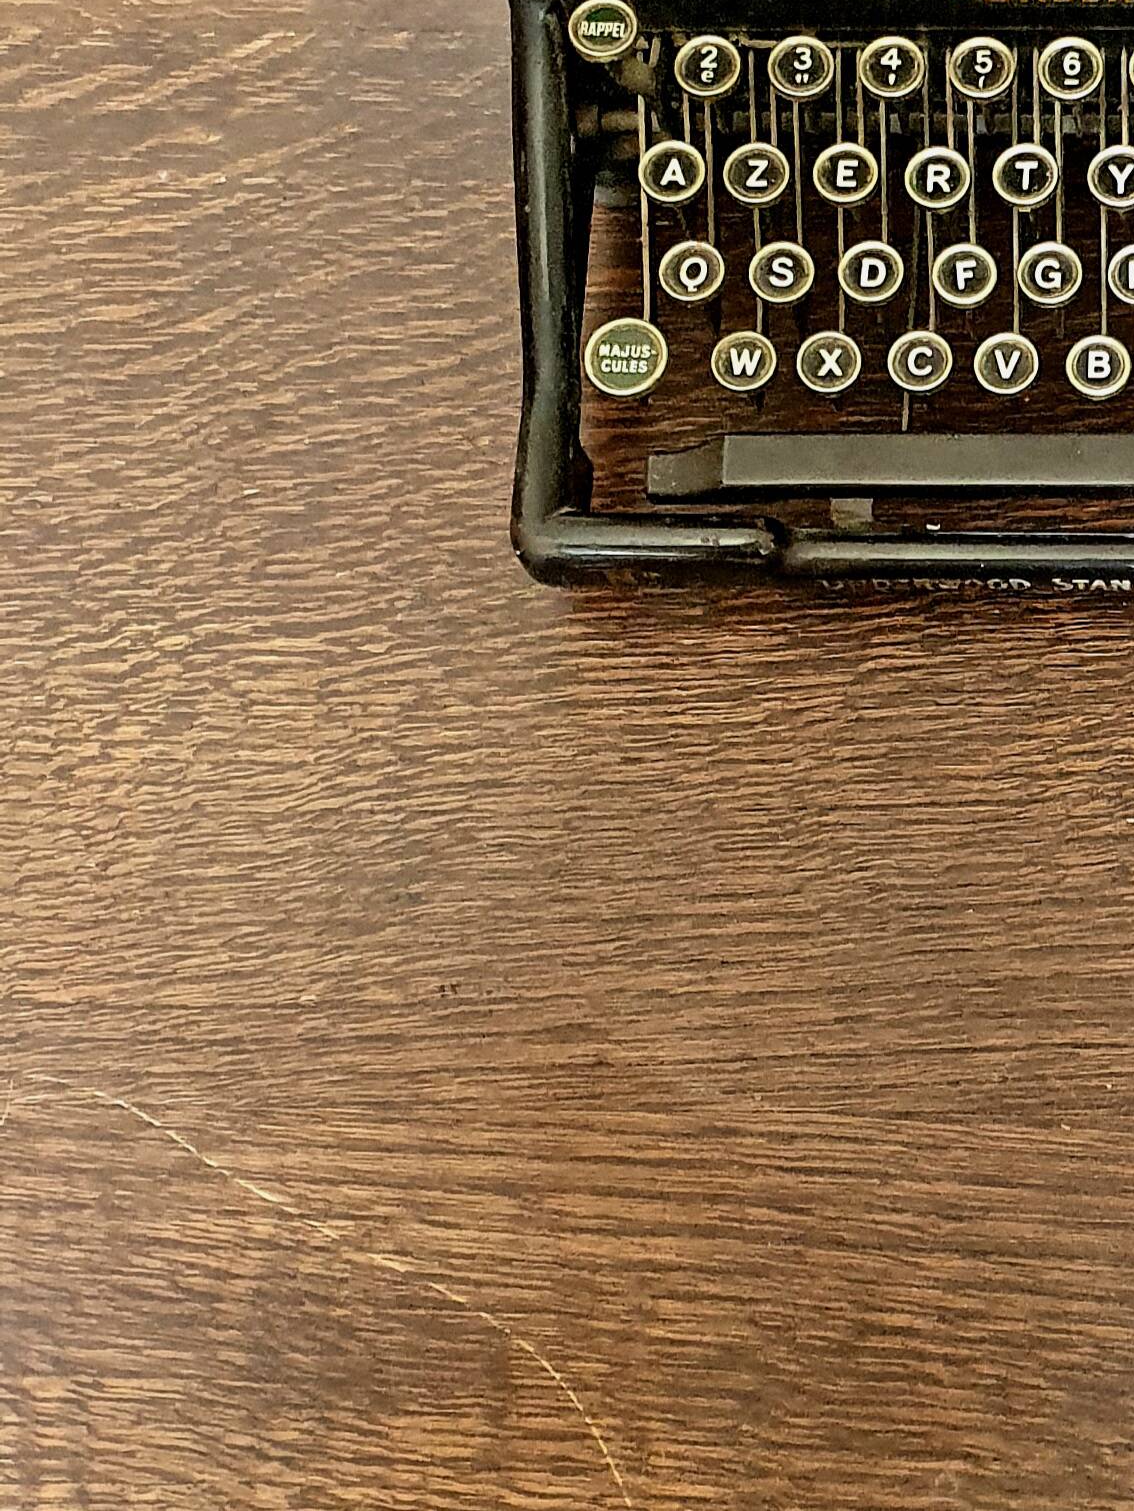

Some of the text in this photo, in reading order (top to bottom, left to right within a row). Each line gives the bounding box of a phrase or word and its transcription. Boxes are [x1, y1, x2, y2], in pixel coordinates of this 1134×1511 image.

[580, 20, 628, 38] RAPPEL
[700, 46, 718, 68] 2
[795, 46, 813, 70] 3
[880, 47, 901, 70] 4
[974, 49, 993, 74] 5
[1063, 51, 1081, 76] 6
[701, 68, 714, 83] é
[660, 158, 686, 186] A
[745, 159, 769, 187] Z
[836, 159, 859, 188] E
[926, 164, 951, 193] R
[1014, 160, 1039, 191] T
[1108, 163, 1134, 195] Y
[680, 257, 708, 292] Q
[768, 256, 794, 287] S
[860, 257, 887, 288] D
[955, 259, 977, 290] F
[1034, 257, 1062, 289] G
[600, 359, 649, 374] CULES
[729, 347, 762, 376] W
[817, 348, 843, 377] X
[907, 346, 933, 376] C
[994, 349, 1021, 379] V
[1087, 349, 1111, 379] B
